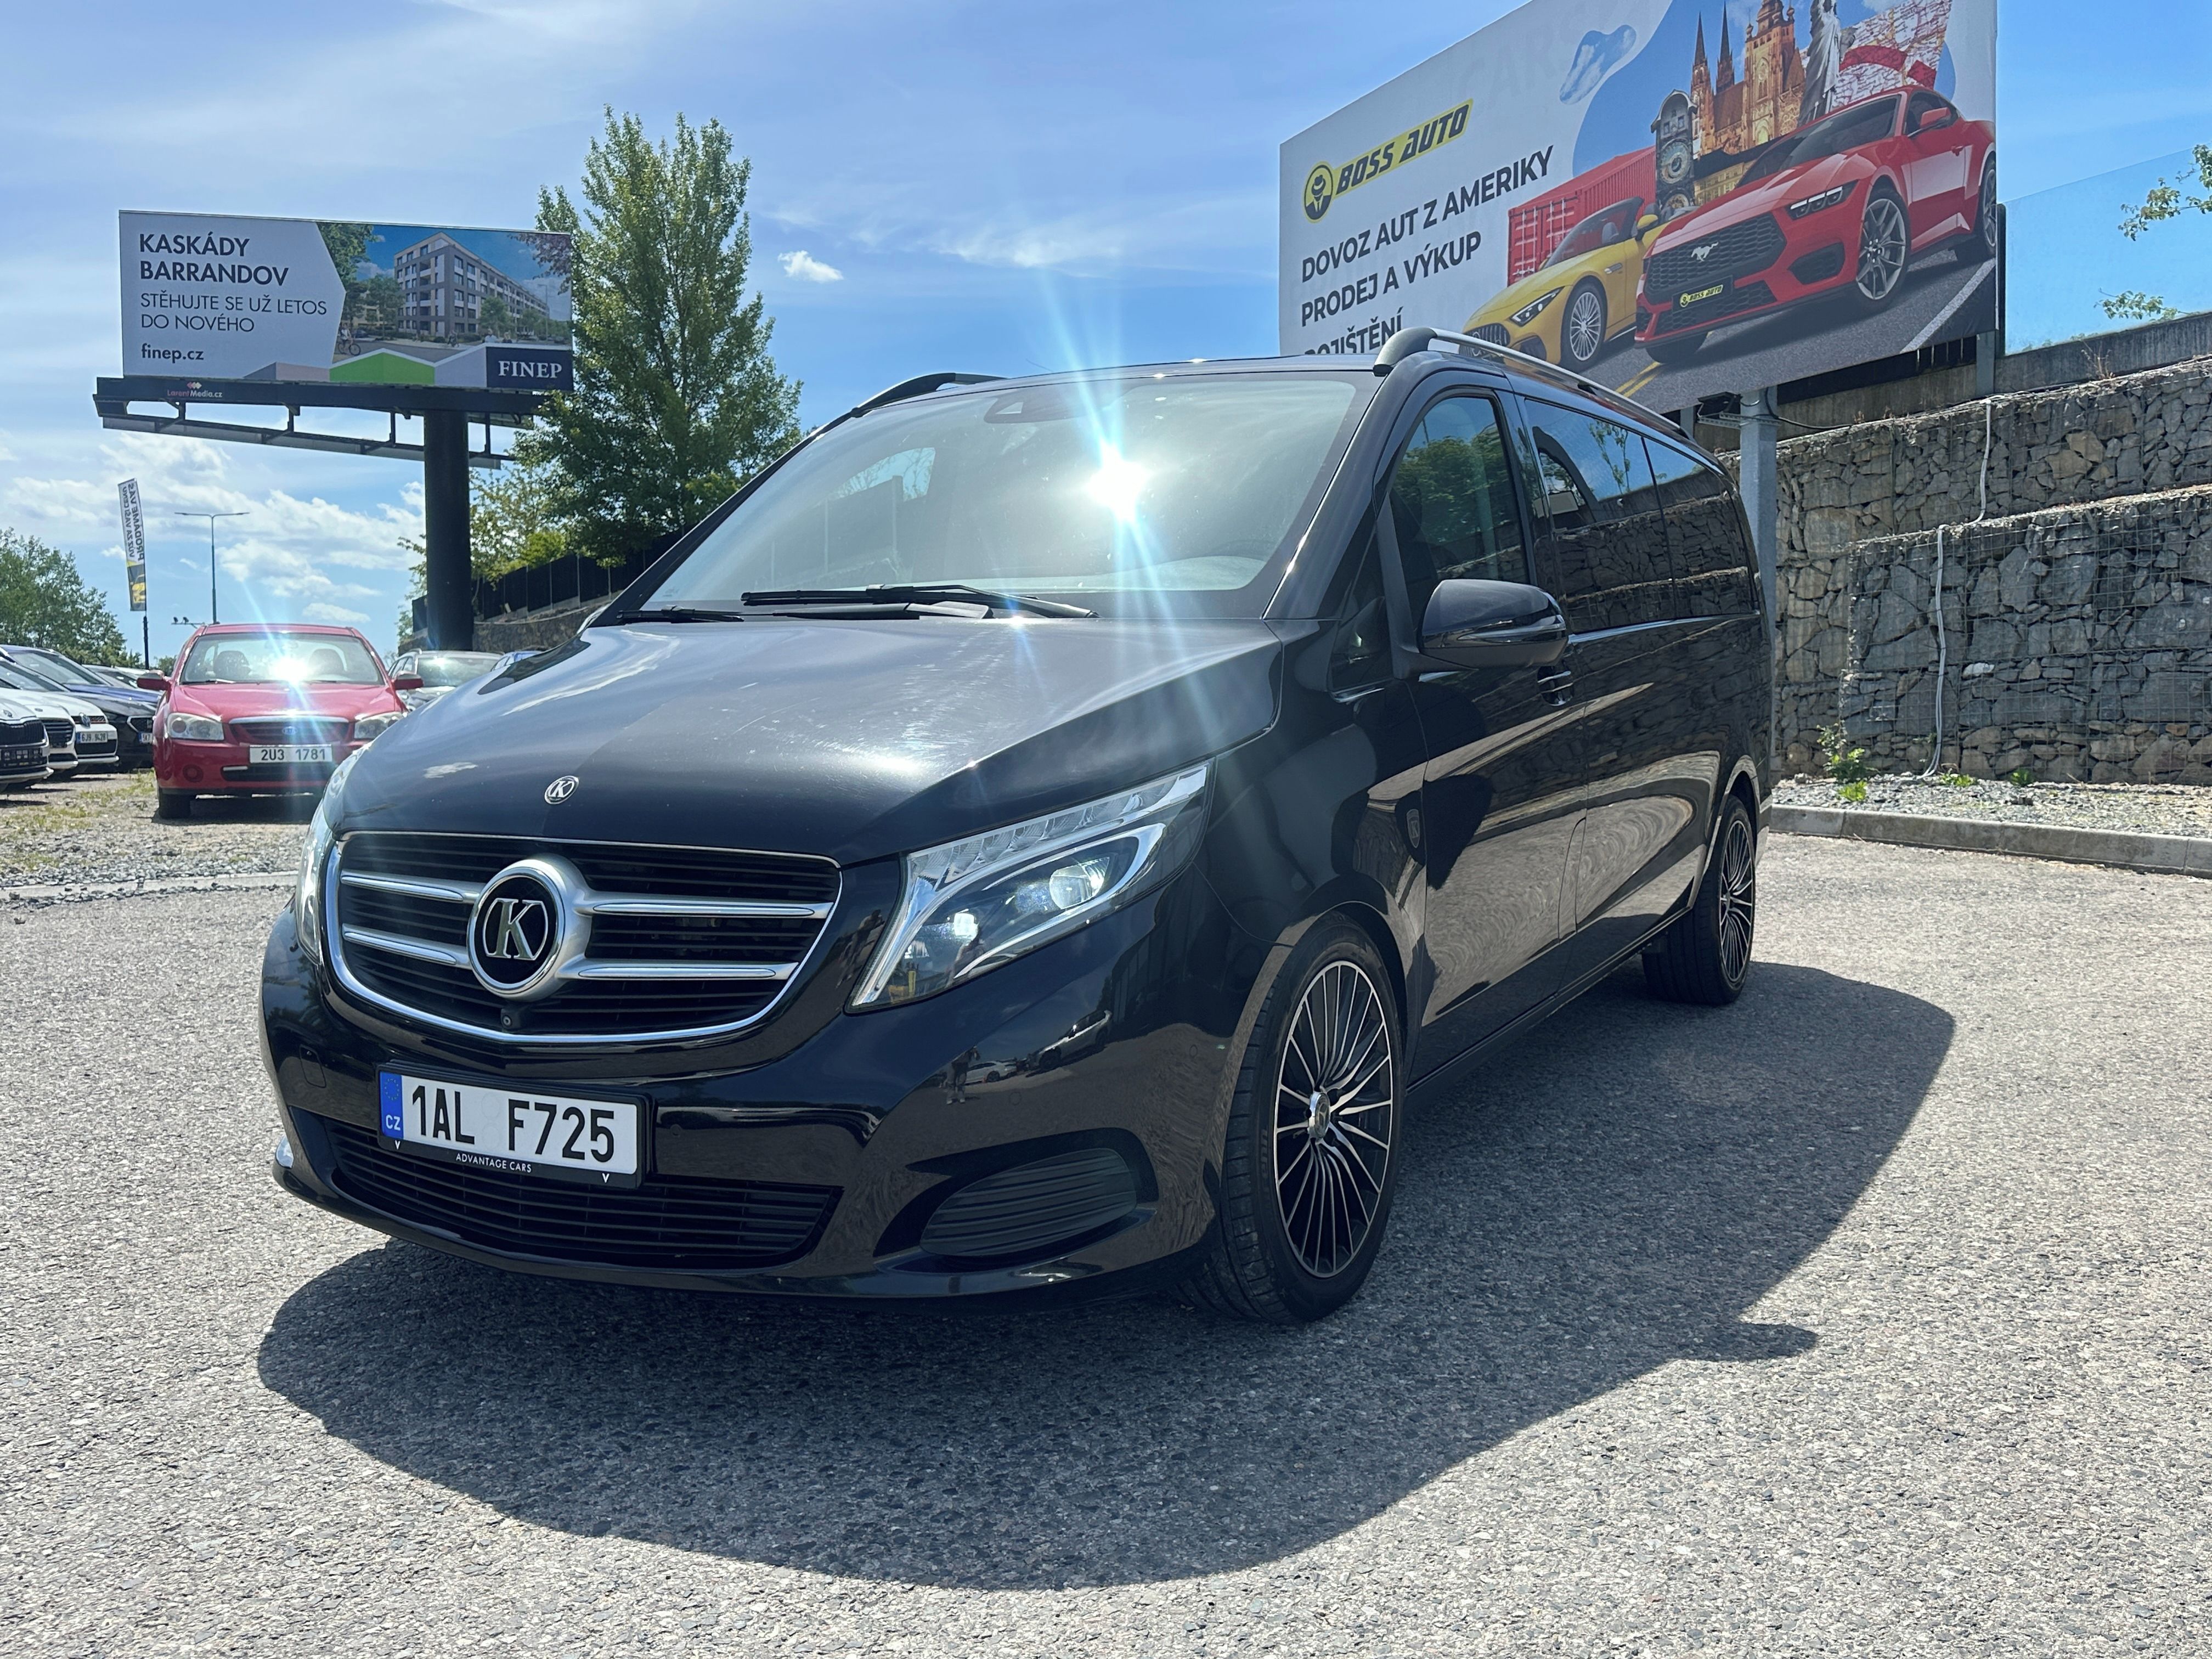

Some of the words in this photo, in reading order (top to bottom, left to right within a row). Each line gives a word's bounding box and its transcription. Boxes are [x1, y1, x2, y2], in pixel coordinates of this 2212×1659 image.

[1335, 142, 1395, 195] BOSS
[1399, 104, 1469, 163] AUTO
[1302, 229, 1370, 283] DOVOZ
[1375, 207, 1419, 251] AUT
[1423, 199, 1437, 229] Z
[1442, 145, 1554, 222] AMERIKY
[140, 232, 250, 257] KASKÁDY
[140, 261, 289, 286] BARRANDOV
[1302, 273, 1378, 327] PRODEJ
[1383, 266, 1399, 294] A
[1403, 231, 1481, 284] VÝKUP
[141, 290, 218, 309] STĚHUJTE
[225, 296, 243, 311] SE
[249, 295, 272, 312] UŽ
[277, 300, 327, 315] LETOS
[141, 314, 169, 329] DO
[176, 313, 254, 332] NOVÉHO
[141, 343, 204, 363] finep.cz
[498, 360, 562, 379] FINEP
[261, 749, 285, 761] 2U3
[295, 749, 325, 760] 1781
[483, 898, 549, 961] K
[385, 1114, 401, 1131] CZ
[412, 1085, 475, 1145] 1AL
[508, 1098, 614, 1163] F725
[456, 1153, 506, 1169] ADVANTAGE
[509, 1161, 532, 1173] CARS
